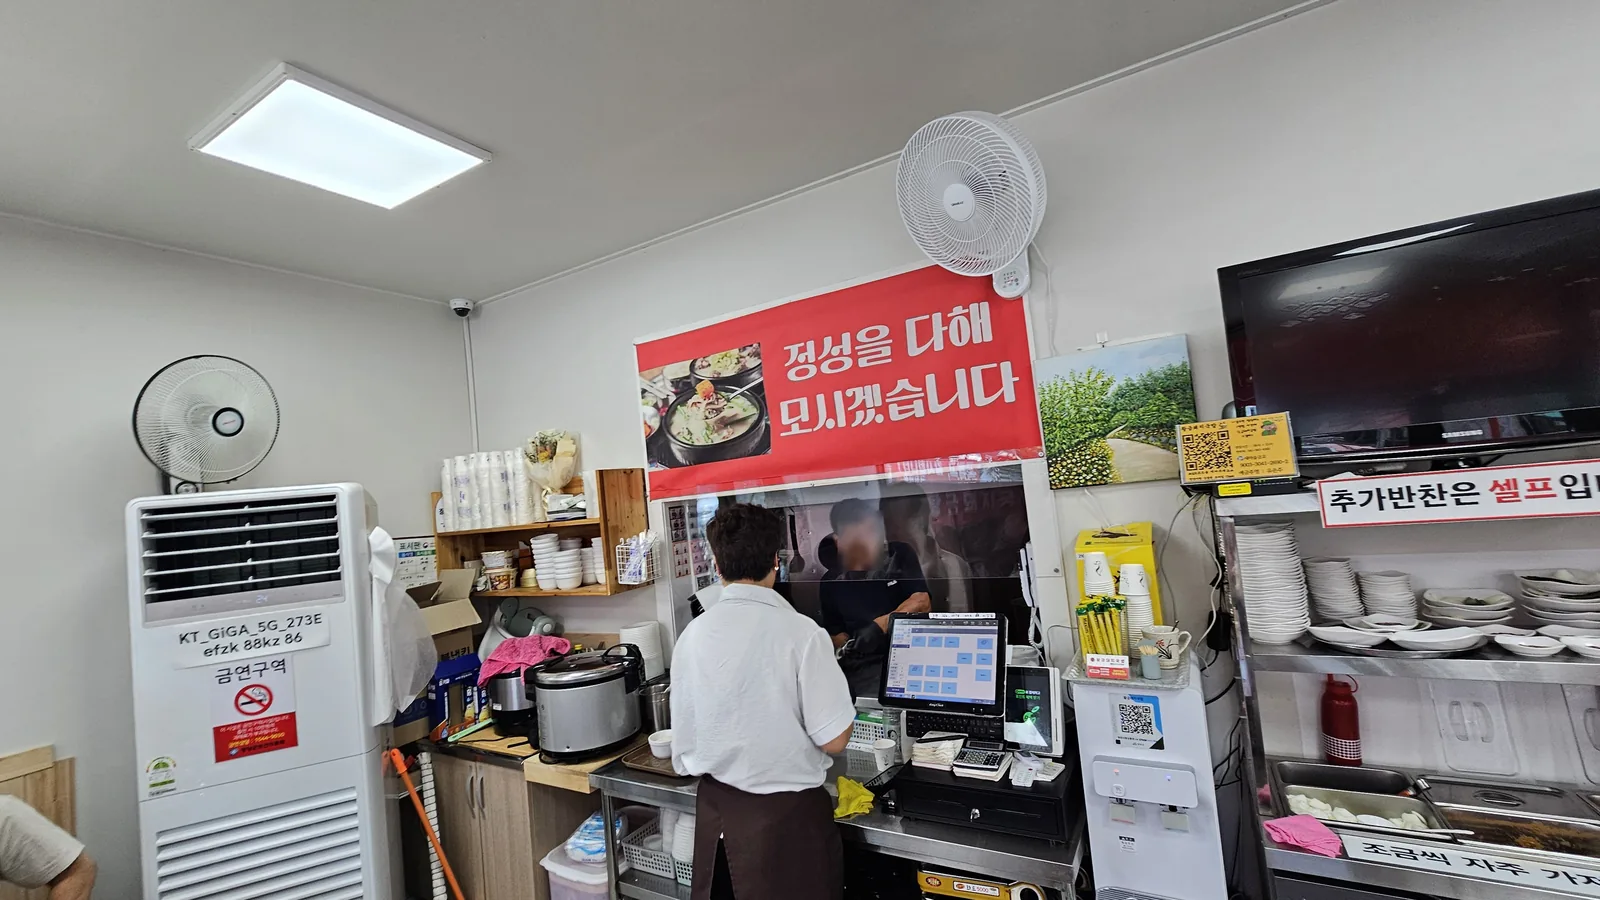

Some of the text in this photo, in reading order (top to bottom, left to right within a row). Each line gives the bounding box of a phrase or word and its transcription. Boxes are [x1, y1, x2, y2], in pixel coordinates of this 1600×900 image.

[784, 301, 993, 382] 정성을 다해
[780, 361, 1020, 437] 모시겠습니다
[1441, 429, 1483, 439] SAMSUNG
[1330, 472, 1600, 513] 추가반찬은 셀프입
[179, 612, 323, 645] KT_GiGA_5G_273E
[203, 631, 303, 657] efzk 88kz 86
[215, 658, 287, 685] 금연구역
[1362, 842, 1452, 866] 조금씩
[1460, 856, 1531, 877] 자주
